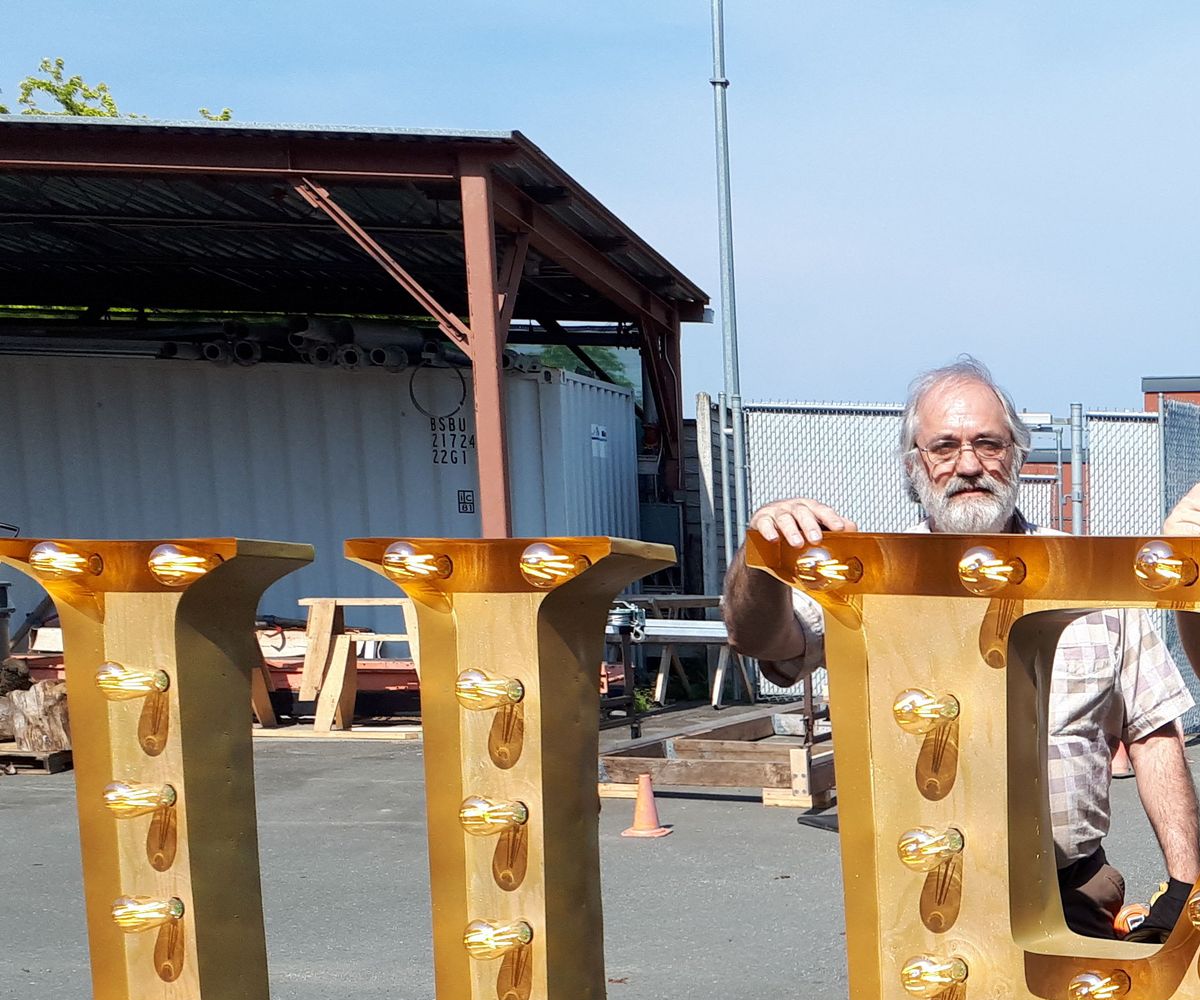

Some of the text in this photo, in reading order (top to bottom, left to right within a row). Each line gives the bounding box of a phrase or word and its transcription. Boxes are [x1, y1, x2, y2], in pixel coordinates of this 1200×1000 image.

[430, 417, 466, 432] BSBU
[432, 433, 475, 449] 21724
[432, 450, 467, 465] 22G1
